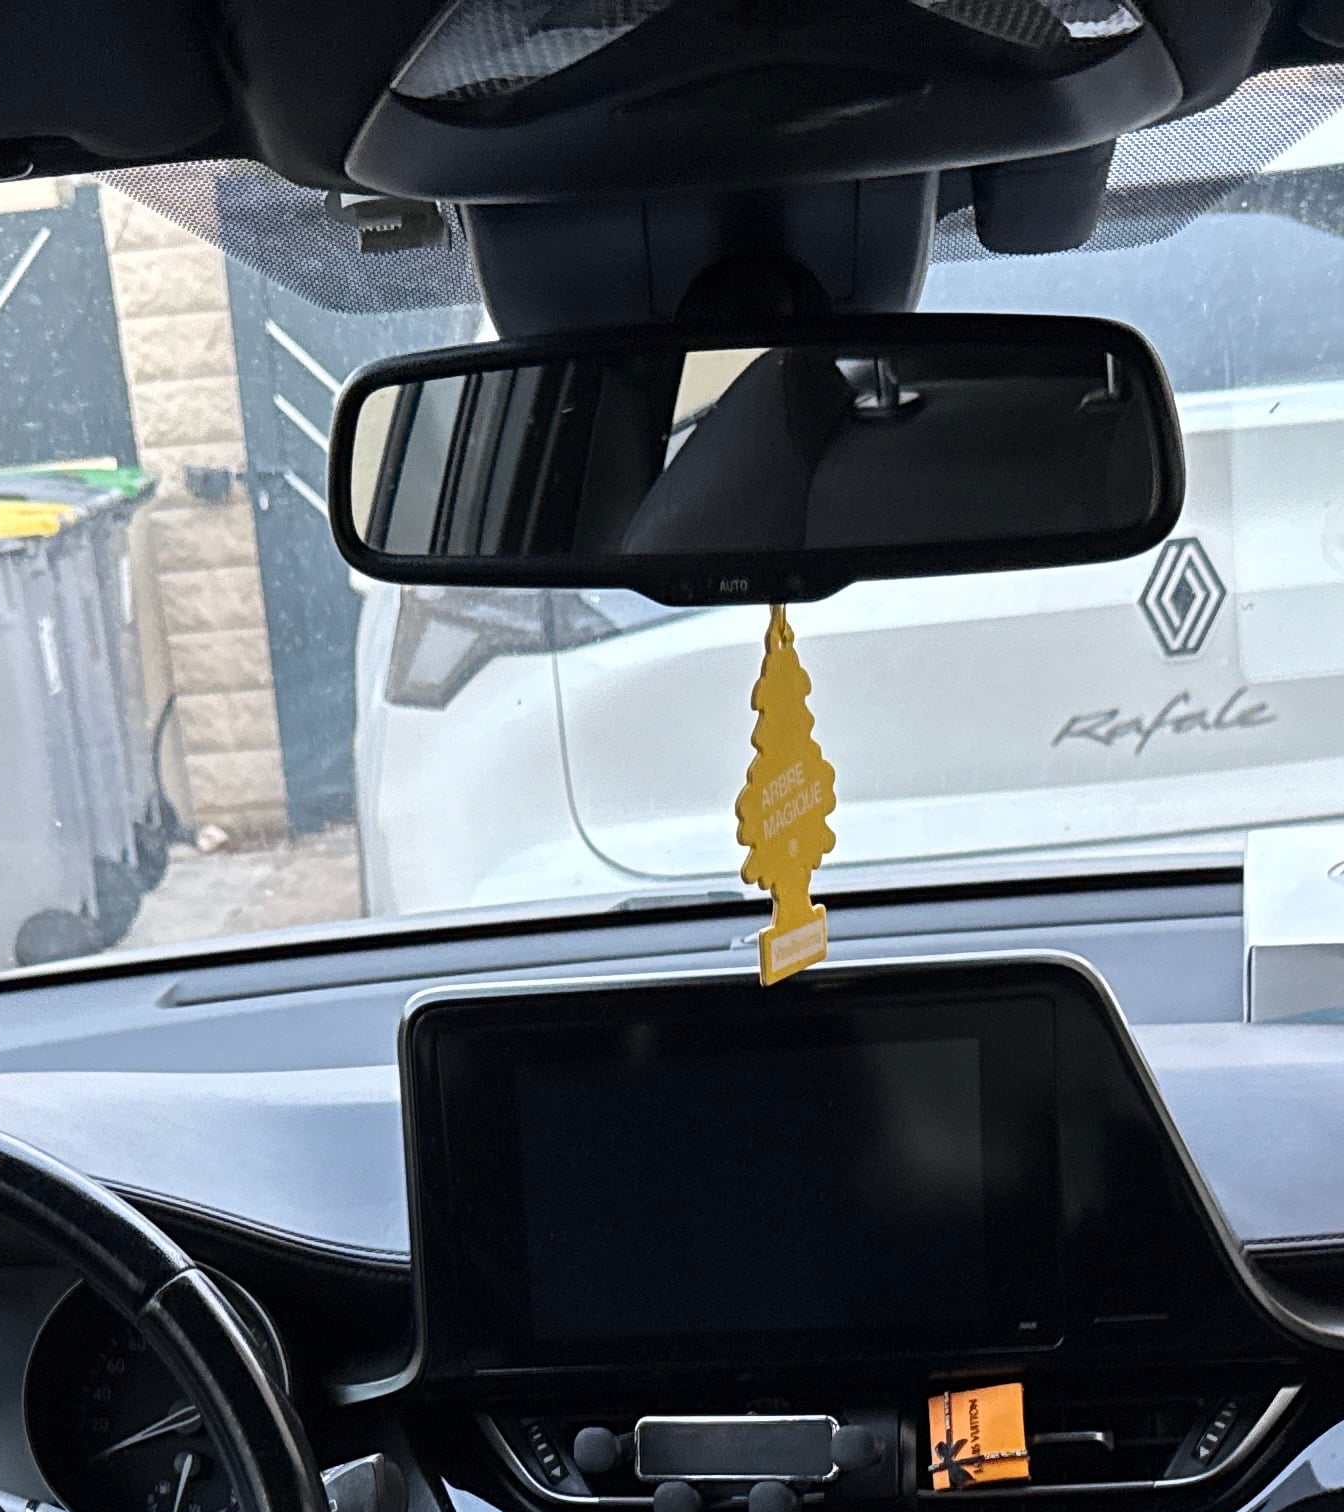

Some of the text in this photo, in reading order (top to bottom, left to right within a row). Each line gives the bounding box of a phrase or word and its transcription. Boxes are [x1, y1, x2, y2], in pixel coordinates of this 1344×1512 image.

[719, 579, 748, 592] AUTO
[1051, 685, 1279, 756] Rafale
[761, 762, 805, 811] ARBRE
[763, 780, 823, 841] MAGIQUE
